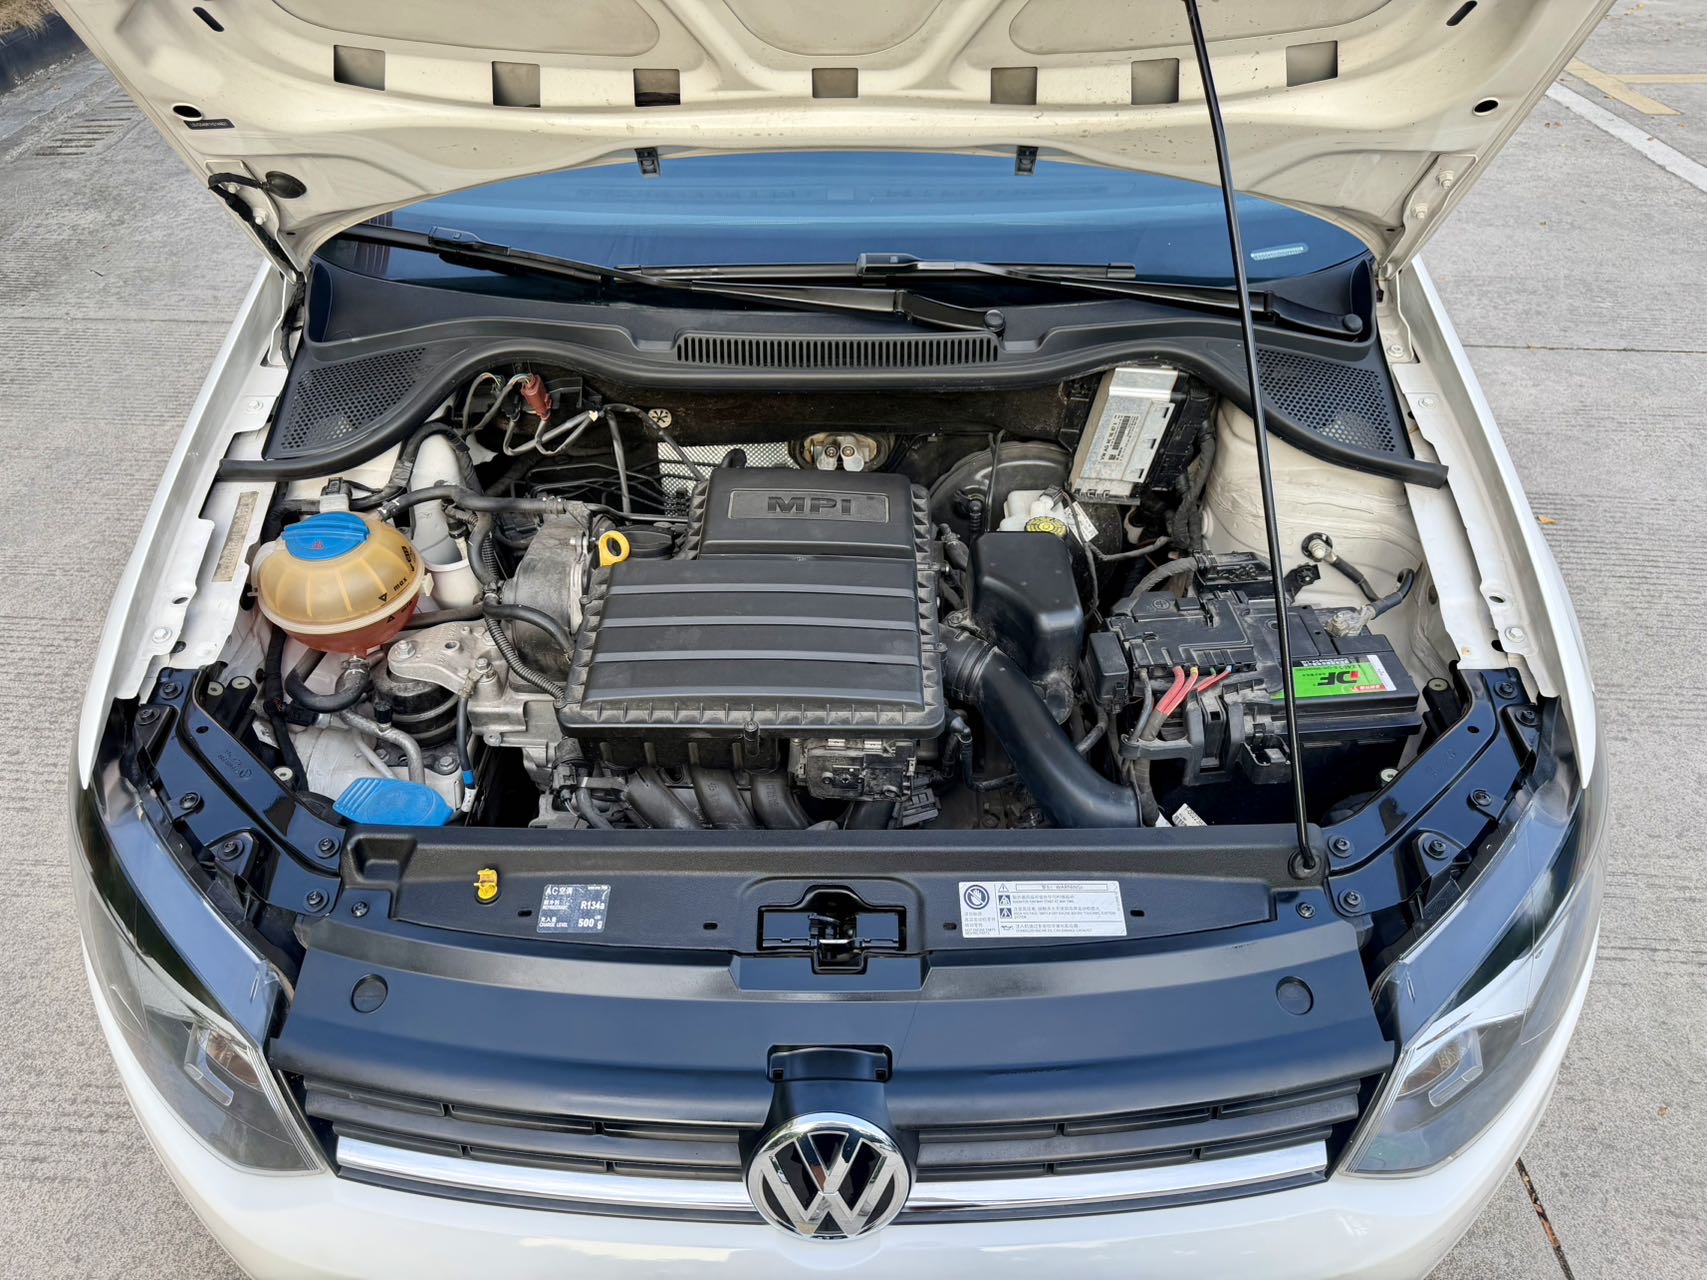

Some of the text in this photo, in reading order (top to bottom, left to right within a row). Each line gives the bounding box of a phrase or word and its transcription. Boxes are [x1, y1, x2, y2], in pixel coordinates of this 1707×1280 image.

[767, 496, 851, 515] MPI
[393, 577, 408, 591] max
[580, 901, 605, 910] R134a
[577, 918, 603, 930] 500 g
